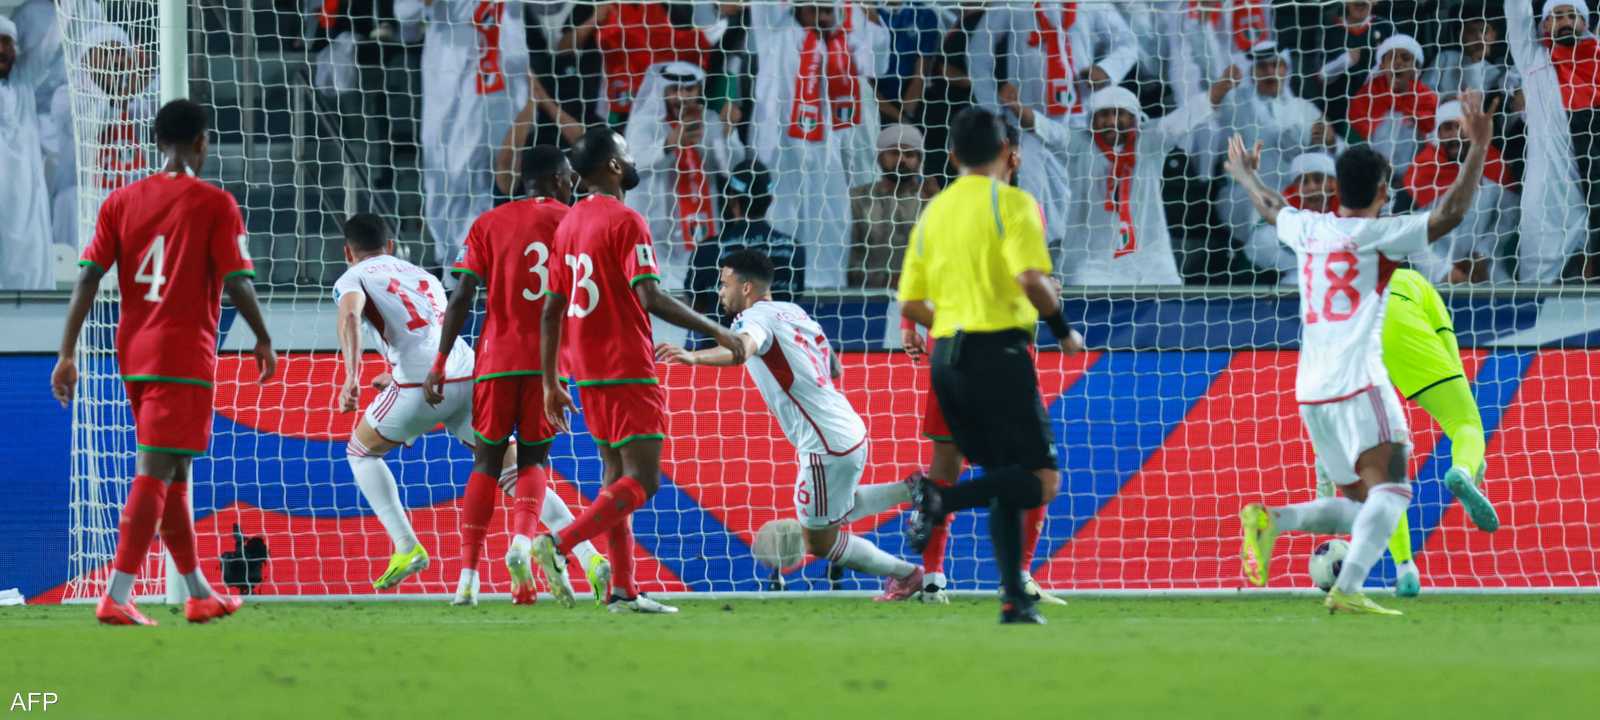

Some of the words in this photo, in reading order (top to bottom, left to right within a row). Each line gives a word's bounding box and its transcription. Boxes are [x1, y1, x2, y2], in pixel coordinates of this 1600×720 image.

[135, 235, 166, 302] 4
[522, 241, 549, 301] 3
[1303, 250, 1361, 324] 18
[386, 277, 445, 331] 11
